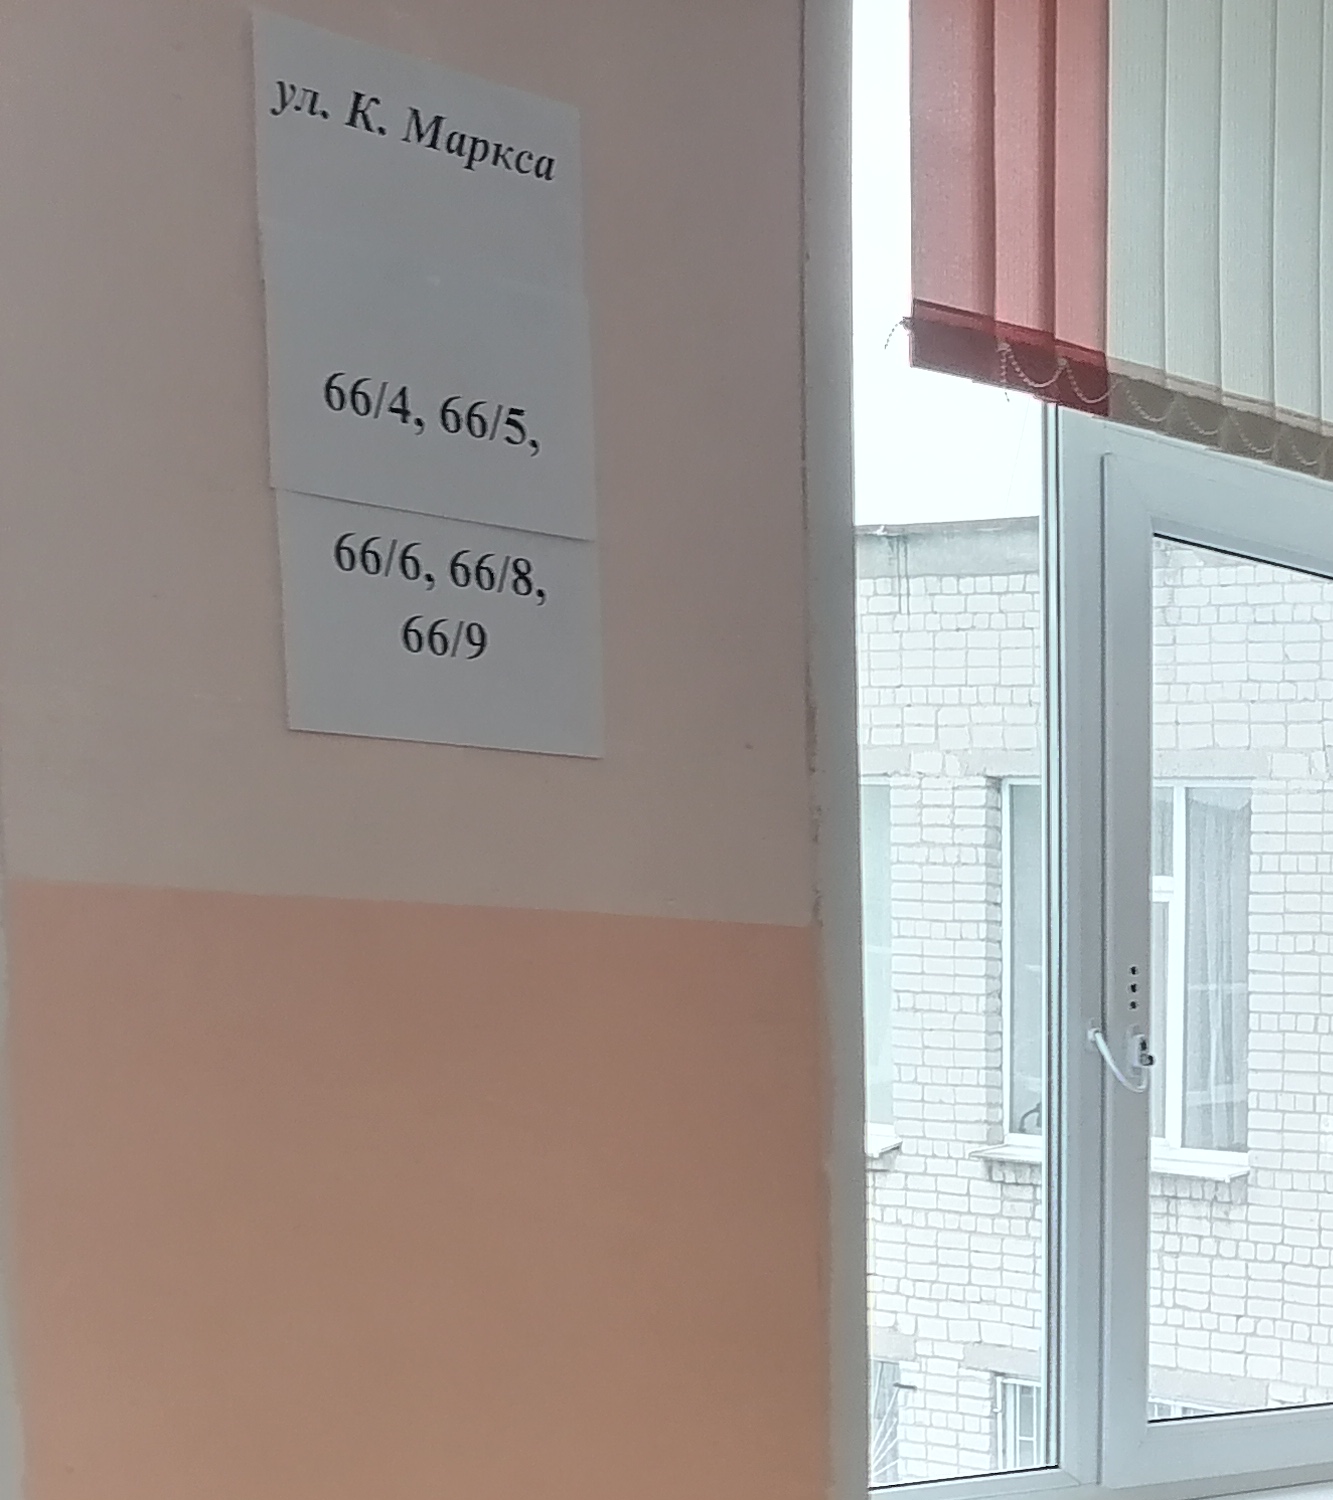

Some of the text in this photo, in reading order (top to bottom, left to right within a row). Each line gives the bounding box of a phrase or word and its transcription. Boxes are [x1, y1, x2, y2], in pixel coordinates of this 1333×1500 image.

[270, 80, 556, 181] ул. К. Маркса
[324, 373, 540, 457] 66/4, 66/5,
[334, 533, 547, 606] 66/6, 66/8,
[402, 616, 488, 660] 66/9
